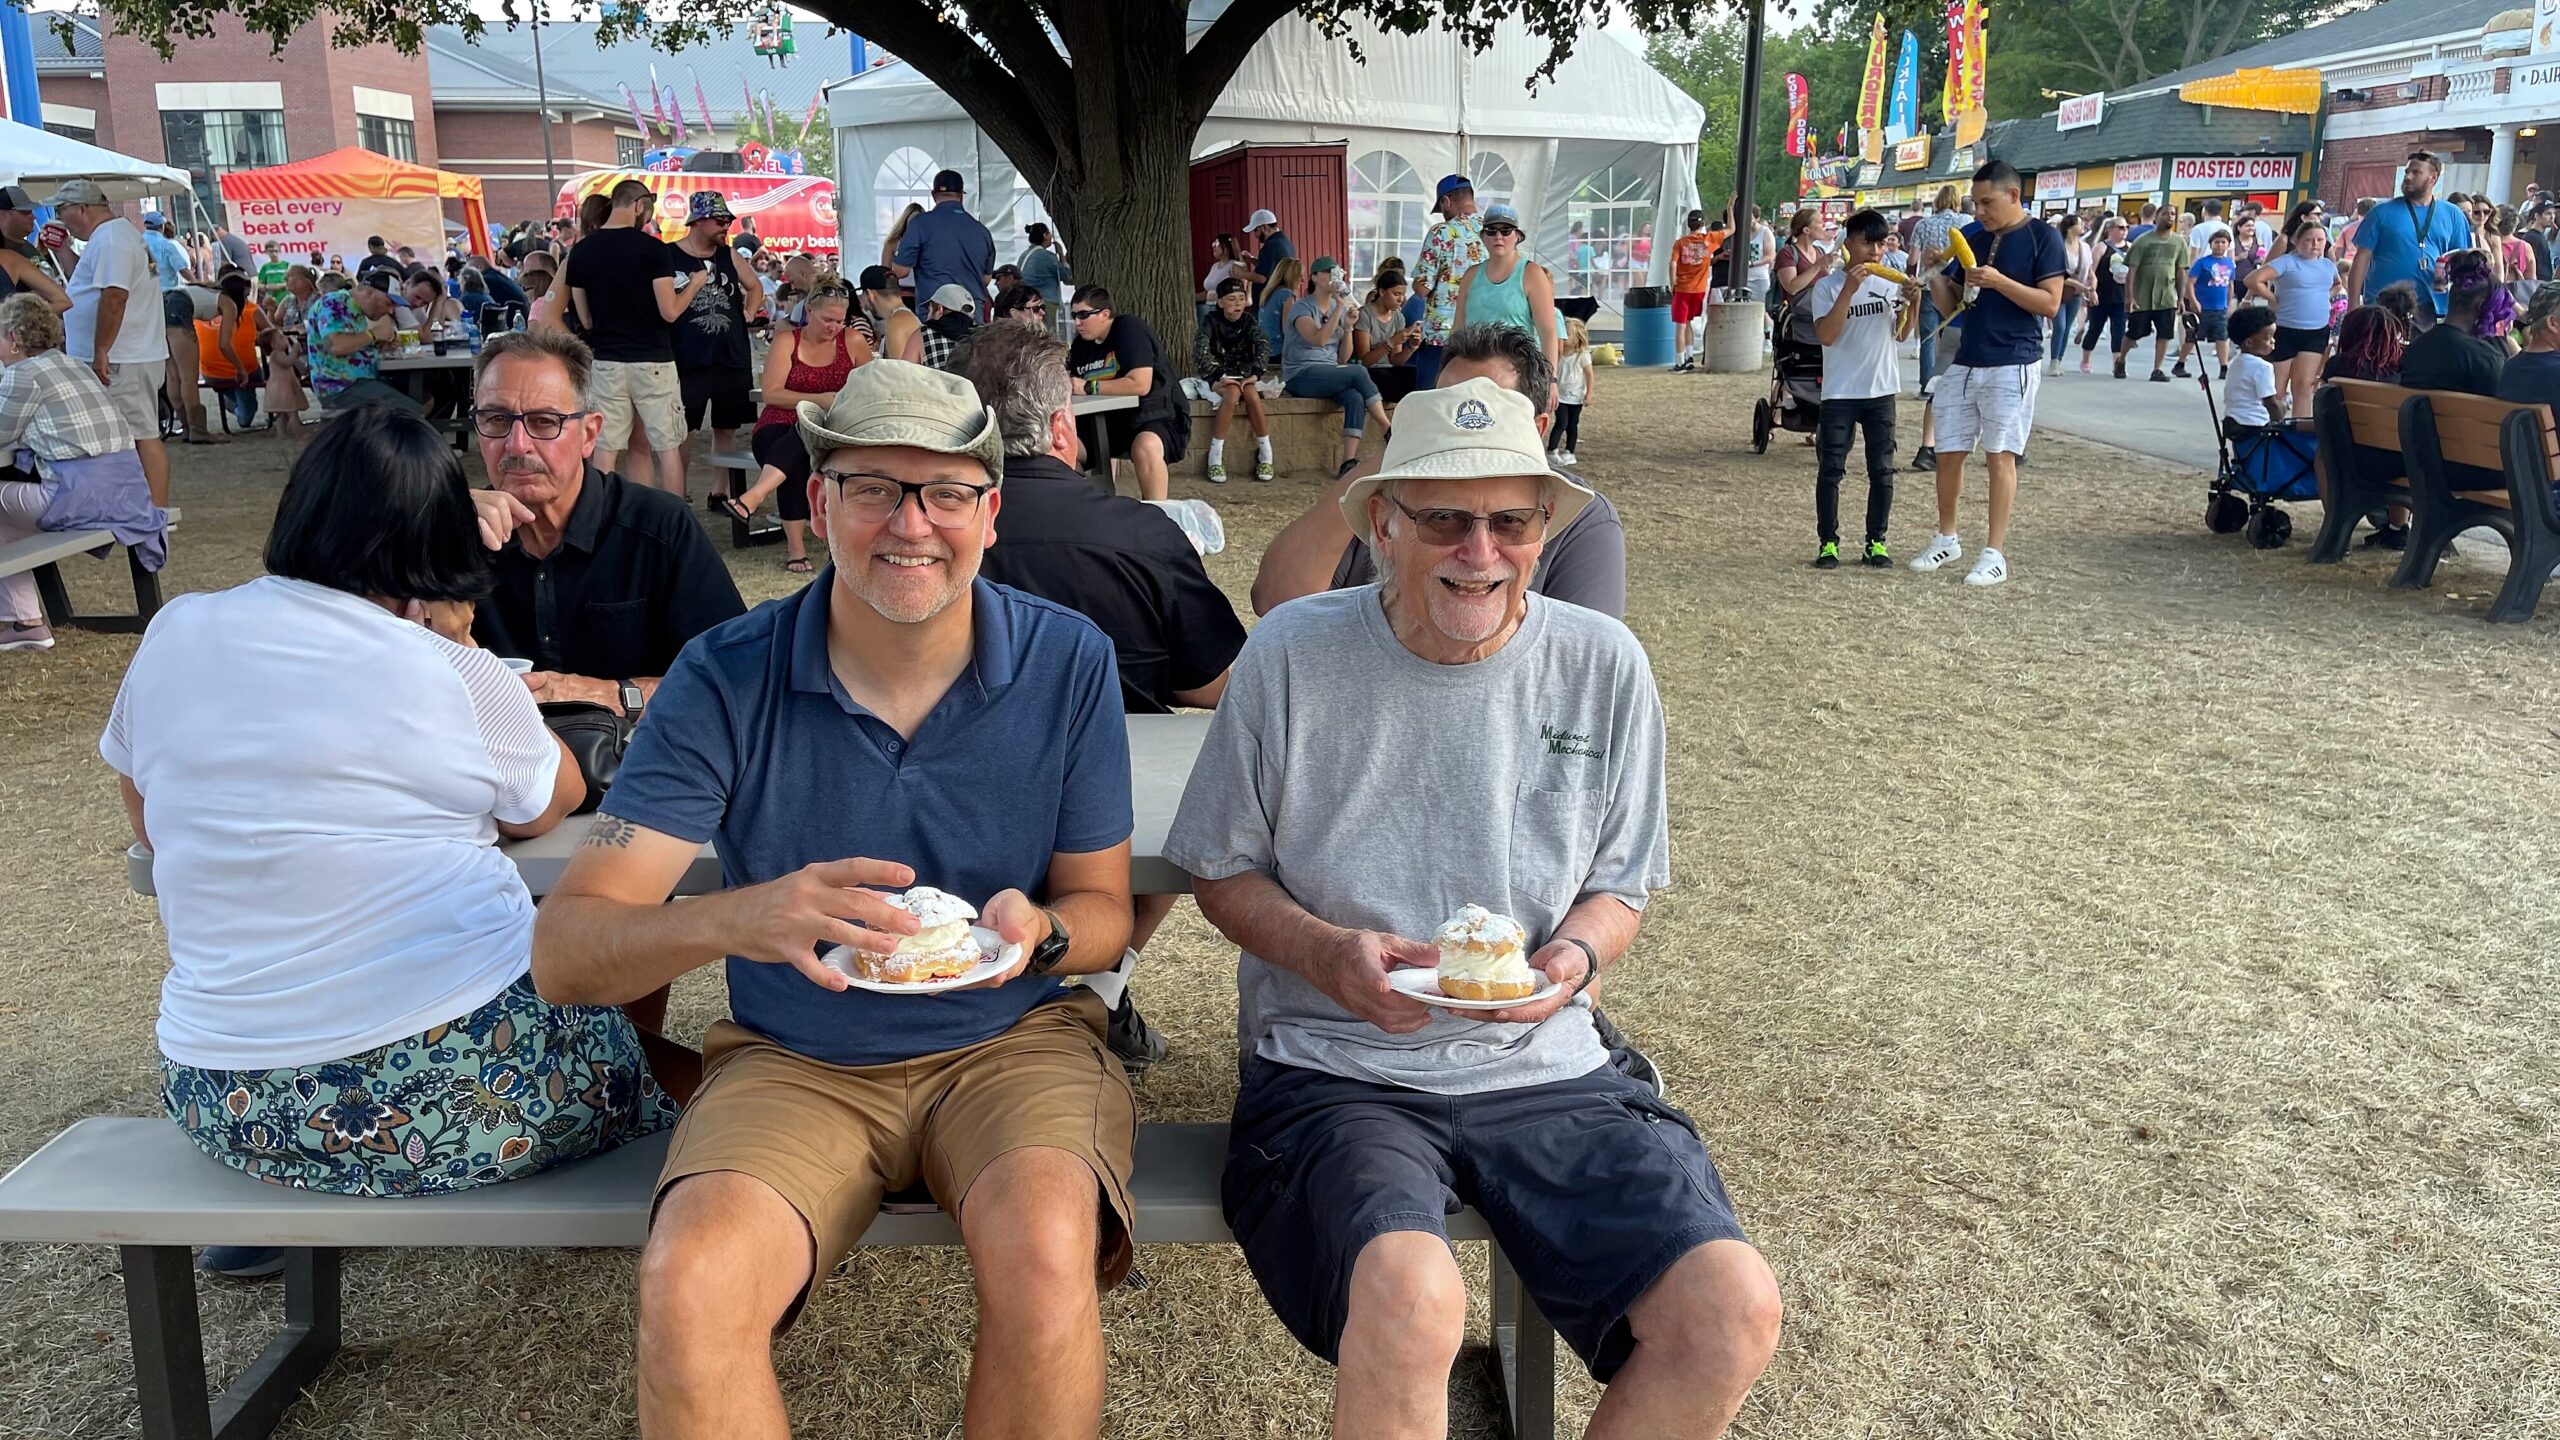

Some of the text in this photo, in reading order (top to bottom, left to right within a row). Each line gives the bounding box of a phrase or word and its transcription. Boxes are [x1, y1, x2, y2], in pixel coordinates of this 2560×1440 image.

[1796, 119, 1806, 154] DOGS
[2176, 160, 2293, 178] ROASTED CORN
[240, 200, 343, 216] Feel every
[243, 219, 315, 235] beat of
[763, 236, 805, 249] every
[1847, 301, 1884, 320] PUMA
[1540, 724, 1590, 743] Midwest
[1548, 740, 1607, 760] Mechanical
